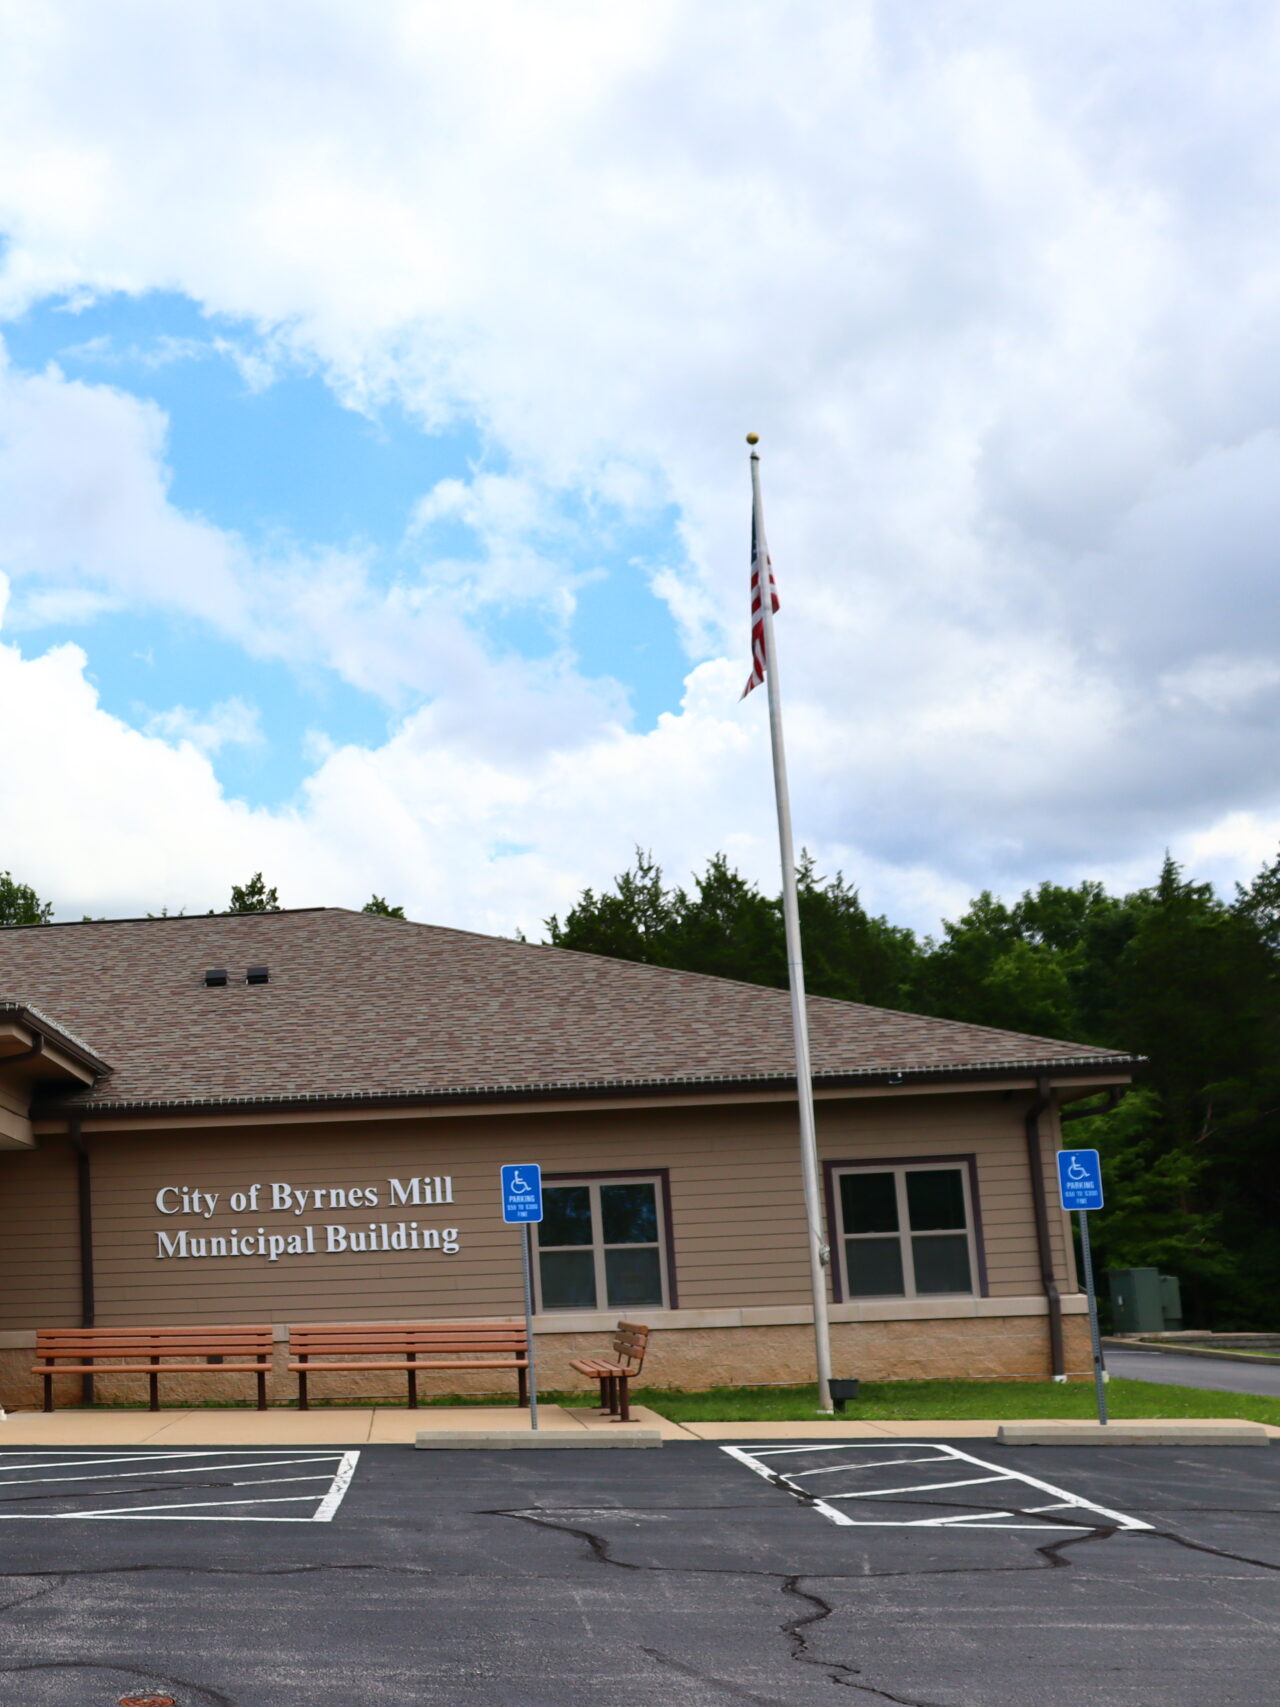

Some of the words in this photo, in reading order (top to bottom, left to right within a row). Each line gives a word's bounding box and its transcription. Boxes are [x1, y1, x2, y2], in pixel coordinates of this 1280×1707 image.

[1066, 1181, 1095, 1189] PARKING
[155, 1186, 220, 1219] City
[230, 1183, 262, 1212] of
[270, 1183, 379, 1216] Byrnes
[387, 1176, 455, 1207] Mill
[508, 1195, 535, 1203] PARKING
[155, 1226, 318, 1262] Municipal
[324, 1222, 461, 1254] Building
